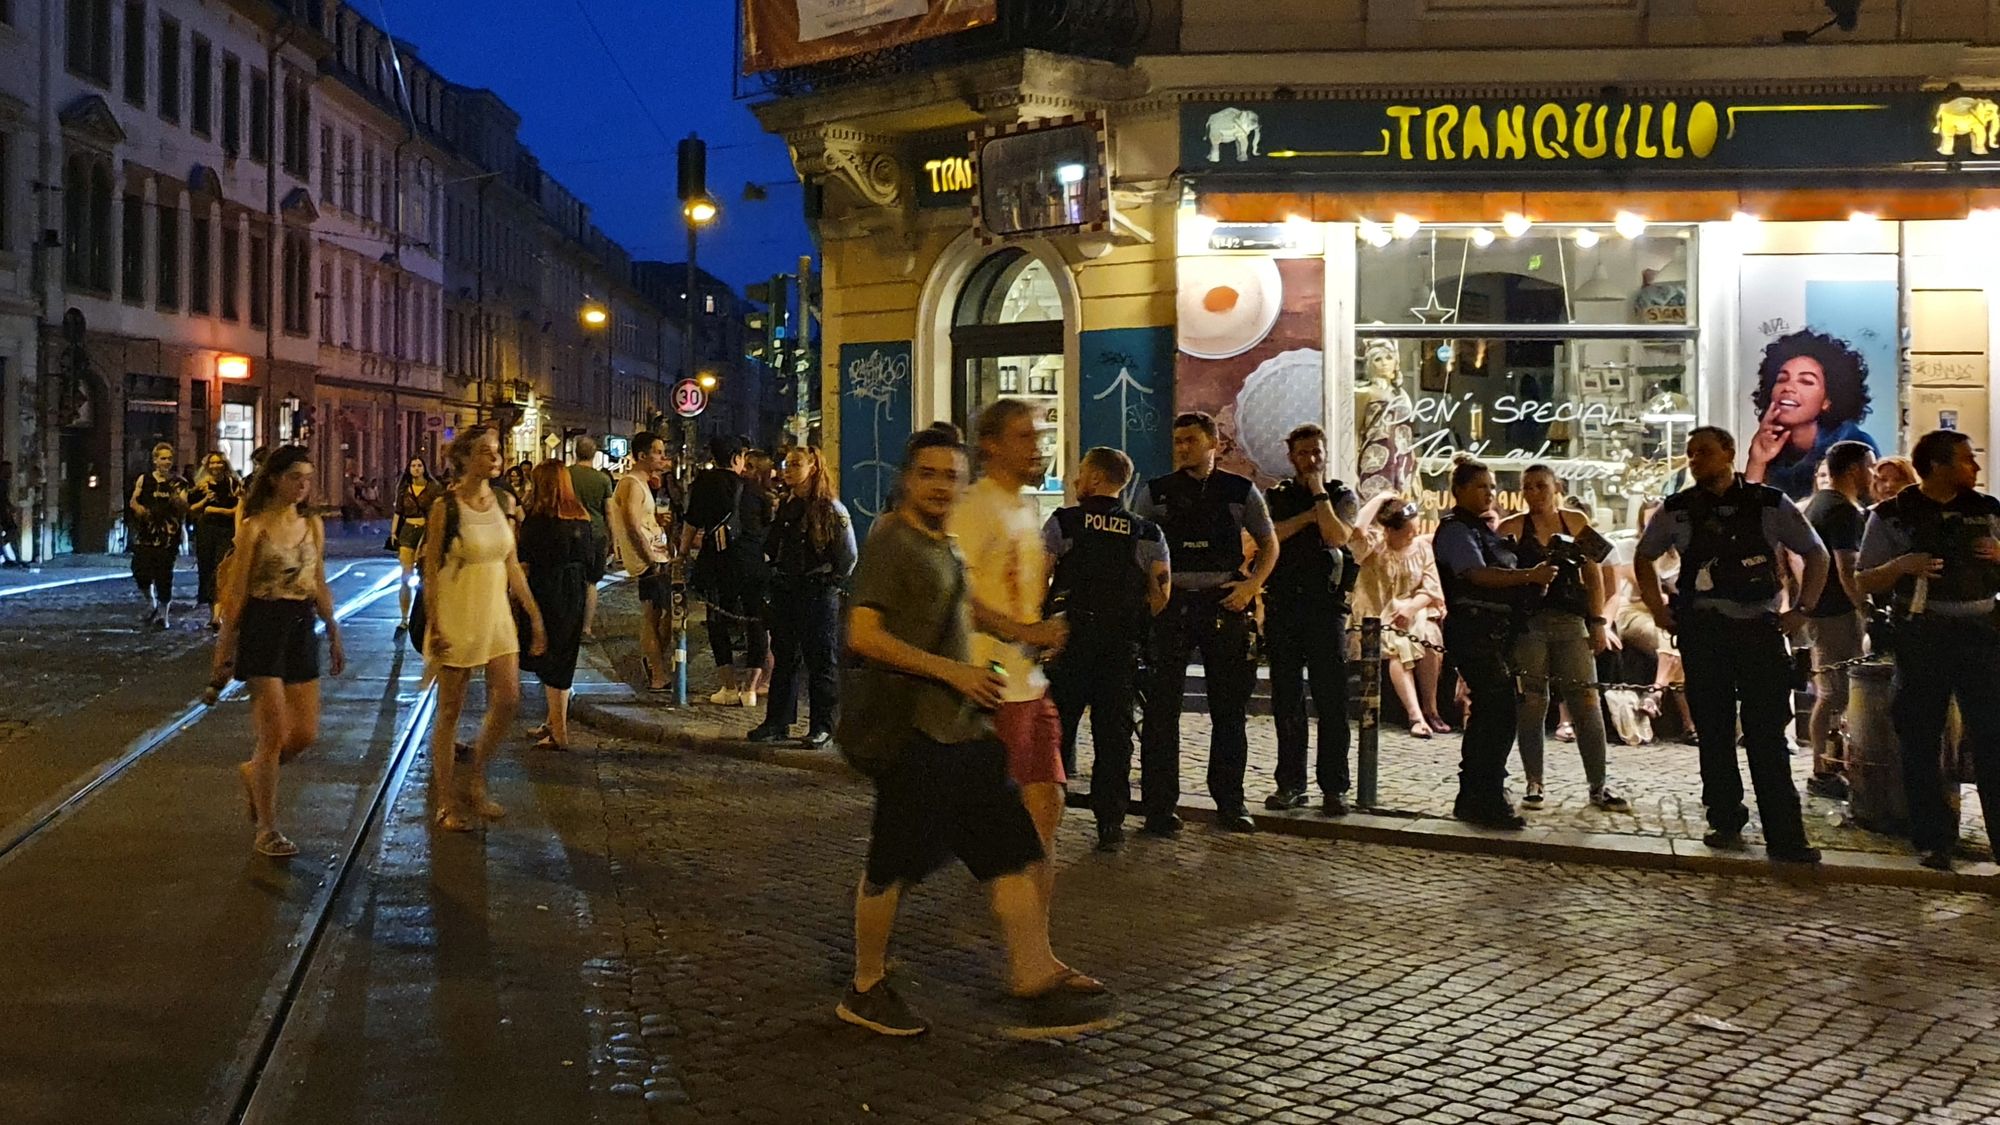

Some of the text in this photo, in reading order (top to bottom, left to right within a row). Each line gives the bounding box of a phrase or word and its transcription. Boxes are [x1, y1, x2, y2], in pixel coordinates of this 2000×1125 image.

[1386, 101, 1718, 160] TRANQUILLO
[679, 389, 699, 406] 30
[1491, 395, 1637, 426] SPECIAL
[1085, 513, 1131, 534] POLIZEI
